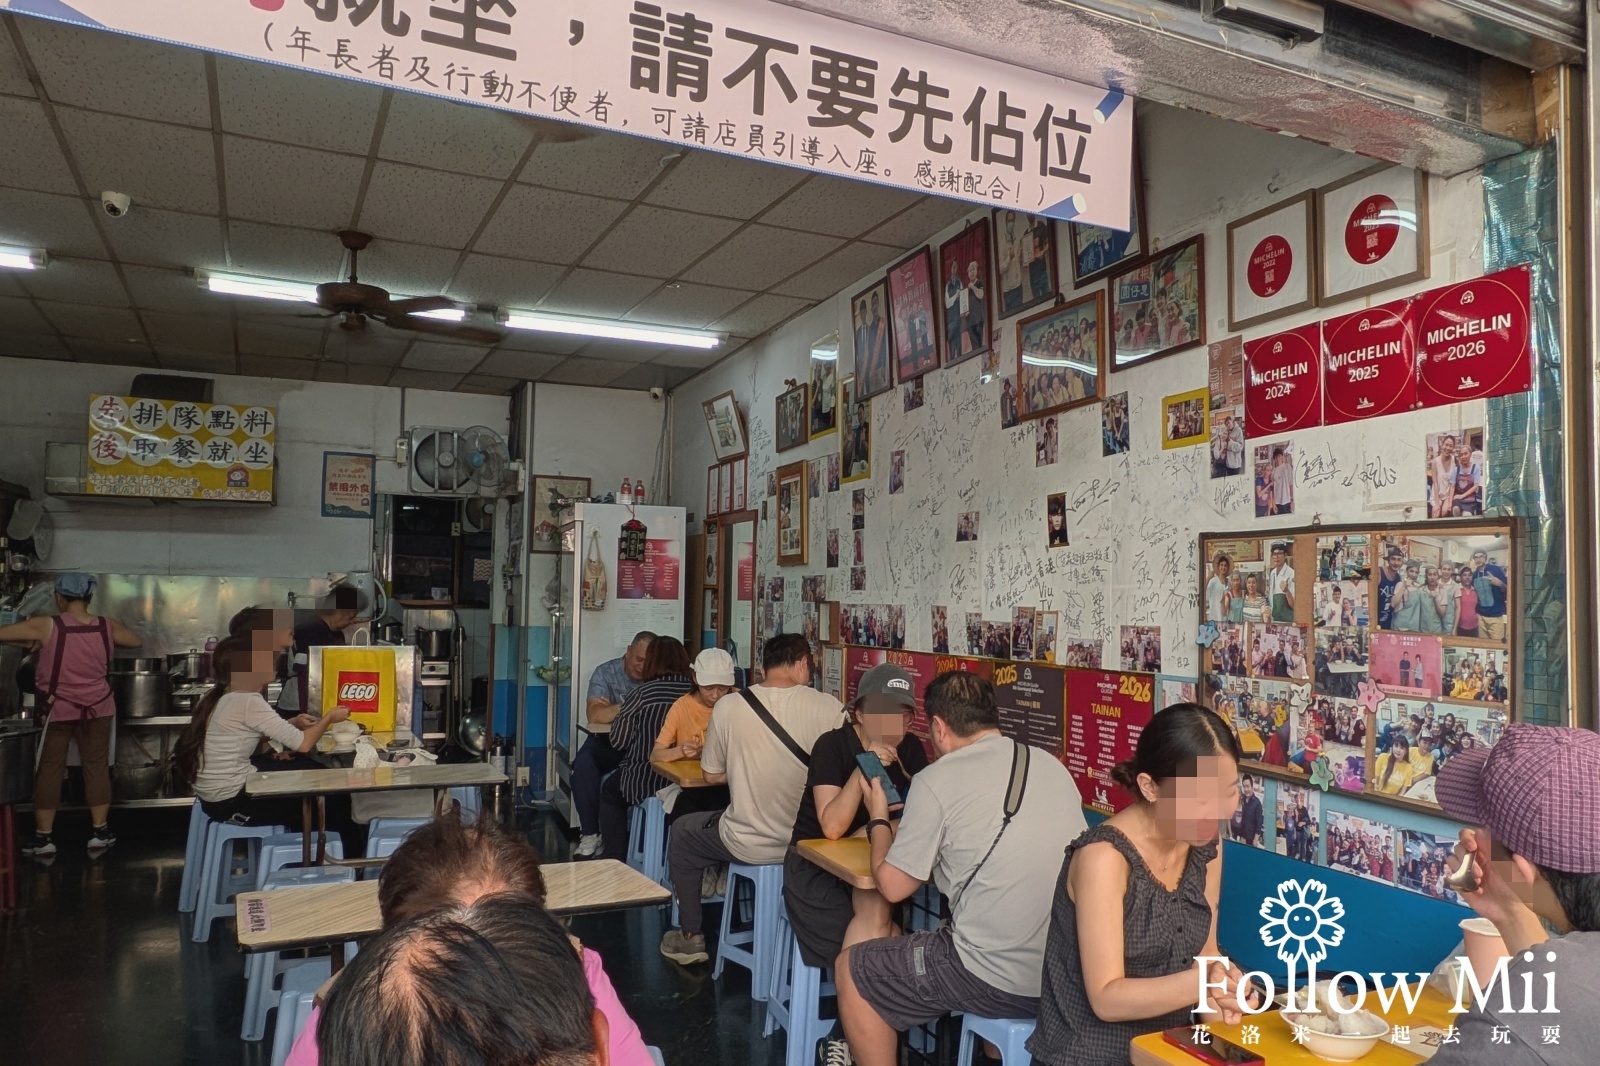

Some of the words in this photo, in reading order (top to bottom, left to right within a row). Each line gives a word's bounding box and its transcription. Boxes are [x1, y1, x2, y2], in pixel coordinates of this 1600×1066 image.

[1254, 247, 1285, 265] MICHELIN
[1262, 258, 1276, 270] 2022
[1427, 313, 1512, 346] MICHELIN
[1331, 340, 1401, 368] MICHELIN
[1447, 340, 1487, 361] 2026
[1251, 360, 1308, 387] MICHELIN
[1348, 364, 1380, 383] 2025
[1264, 383, 1291, 400] 2024
[97, 397, 273, 435] 先排隊點料
[92, 434, 269, 465] 後取餐就坐
[995, 664, 1017, 686] 2025
[340, 685, 376, 700] LEGO
[1118, 674, 1152, 703] 2026
[1090, 703, 1121, 719] TAINAN
